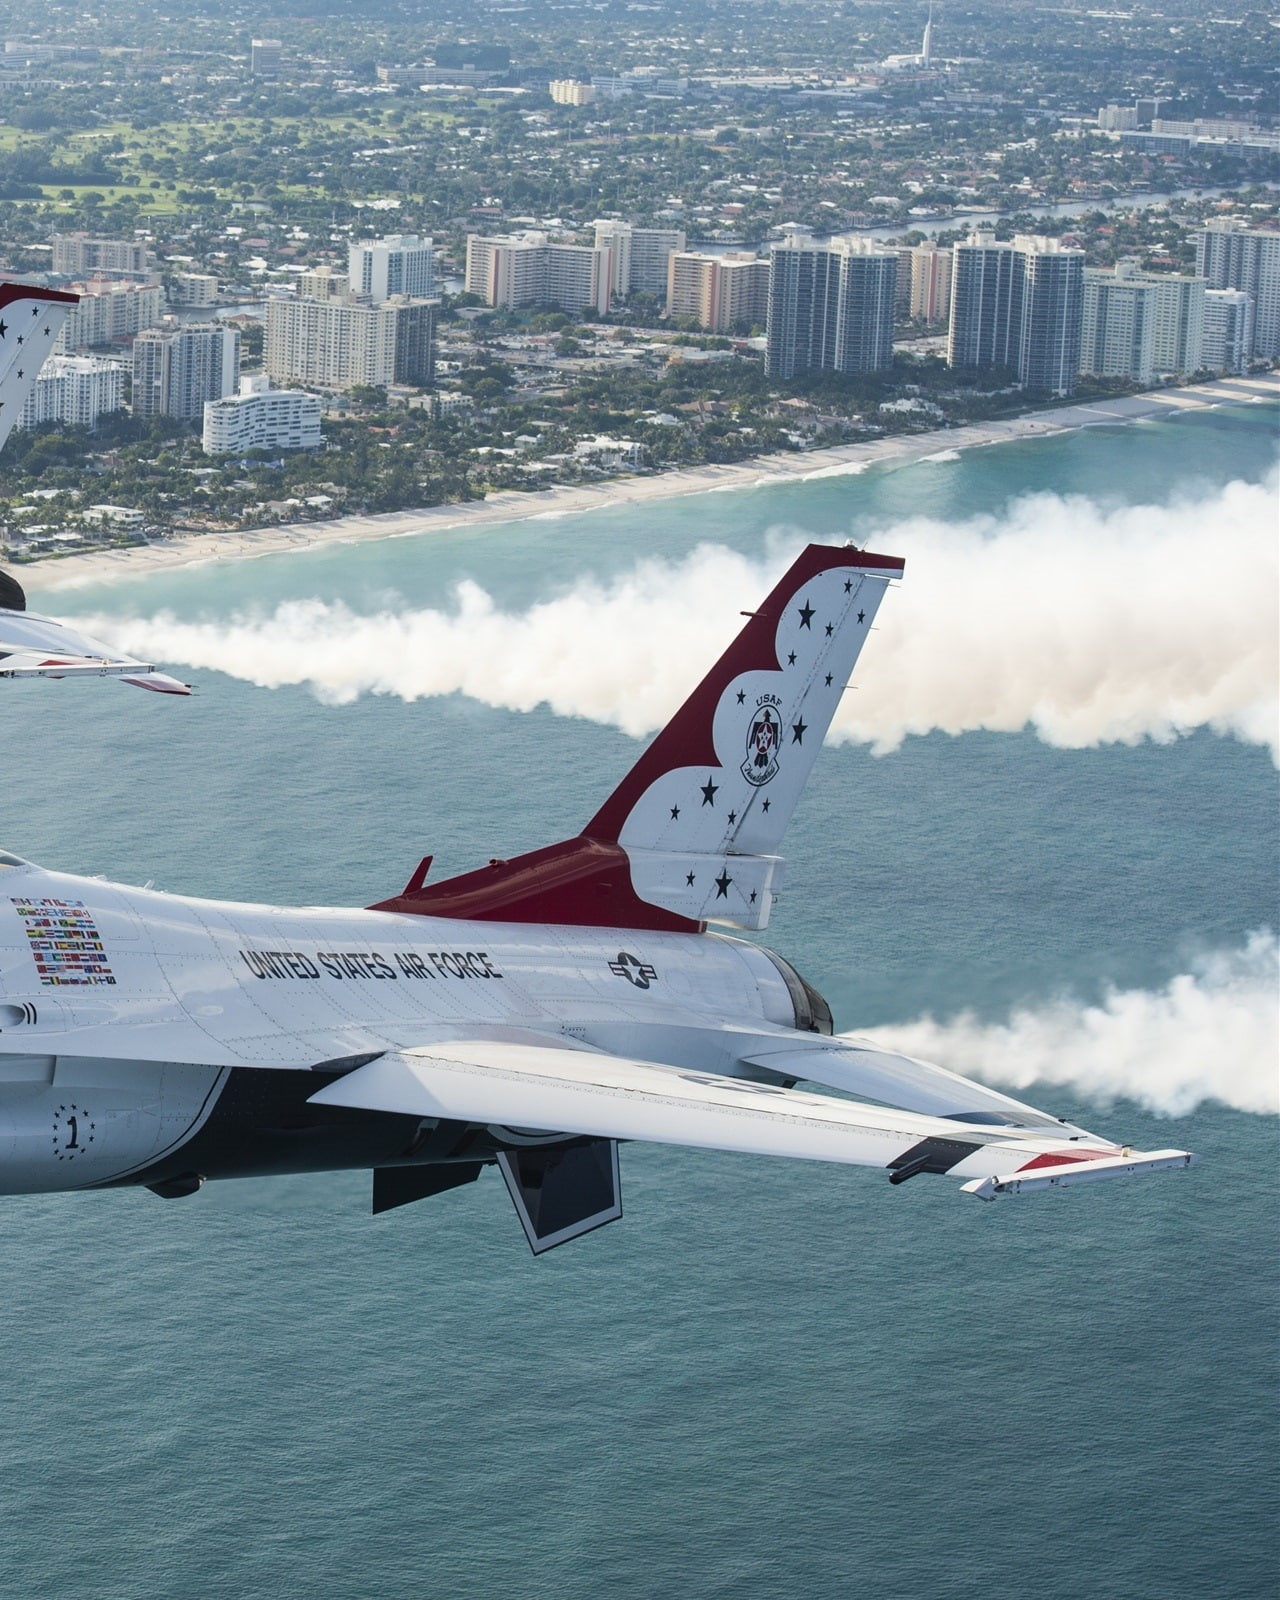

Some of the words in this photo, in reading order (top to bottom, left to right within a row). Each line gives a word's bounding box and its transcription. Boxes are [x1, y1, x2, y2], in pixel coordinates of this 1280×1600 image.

[755, 693, 783, 707] USAF
[238, 950, 320, 980] UNITED
[317, 952, 398, 980] STATES
[393, 952, 437, 979] AIR
[426, 951, 504, 980] FORCE
[65, 1115, 79, 1149] 1
